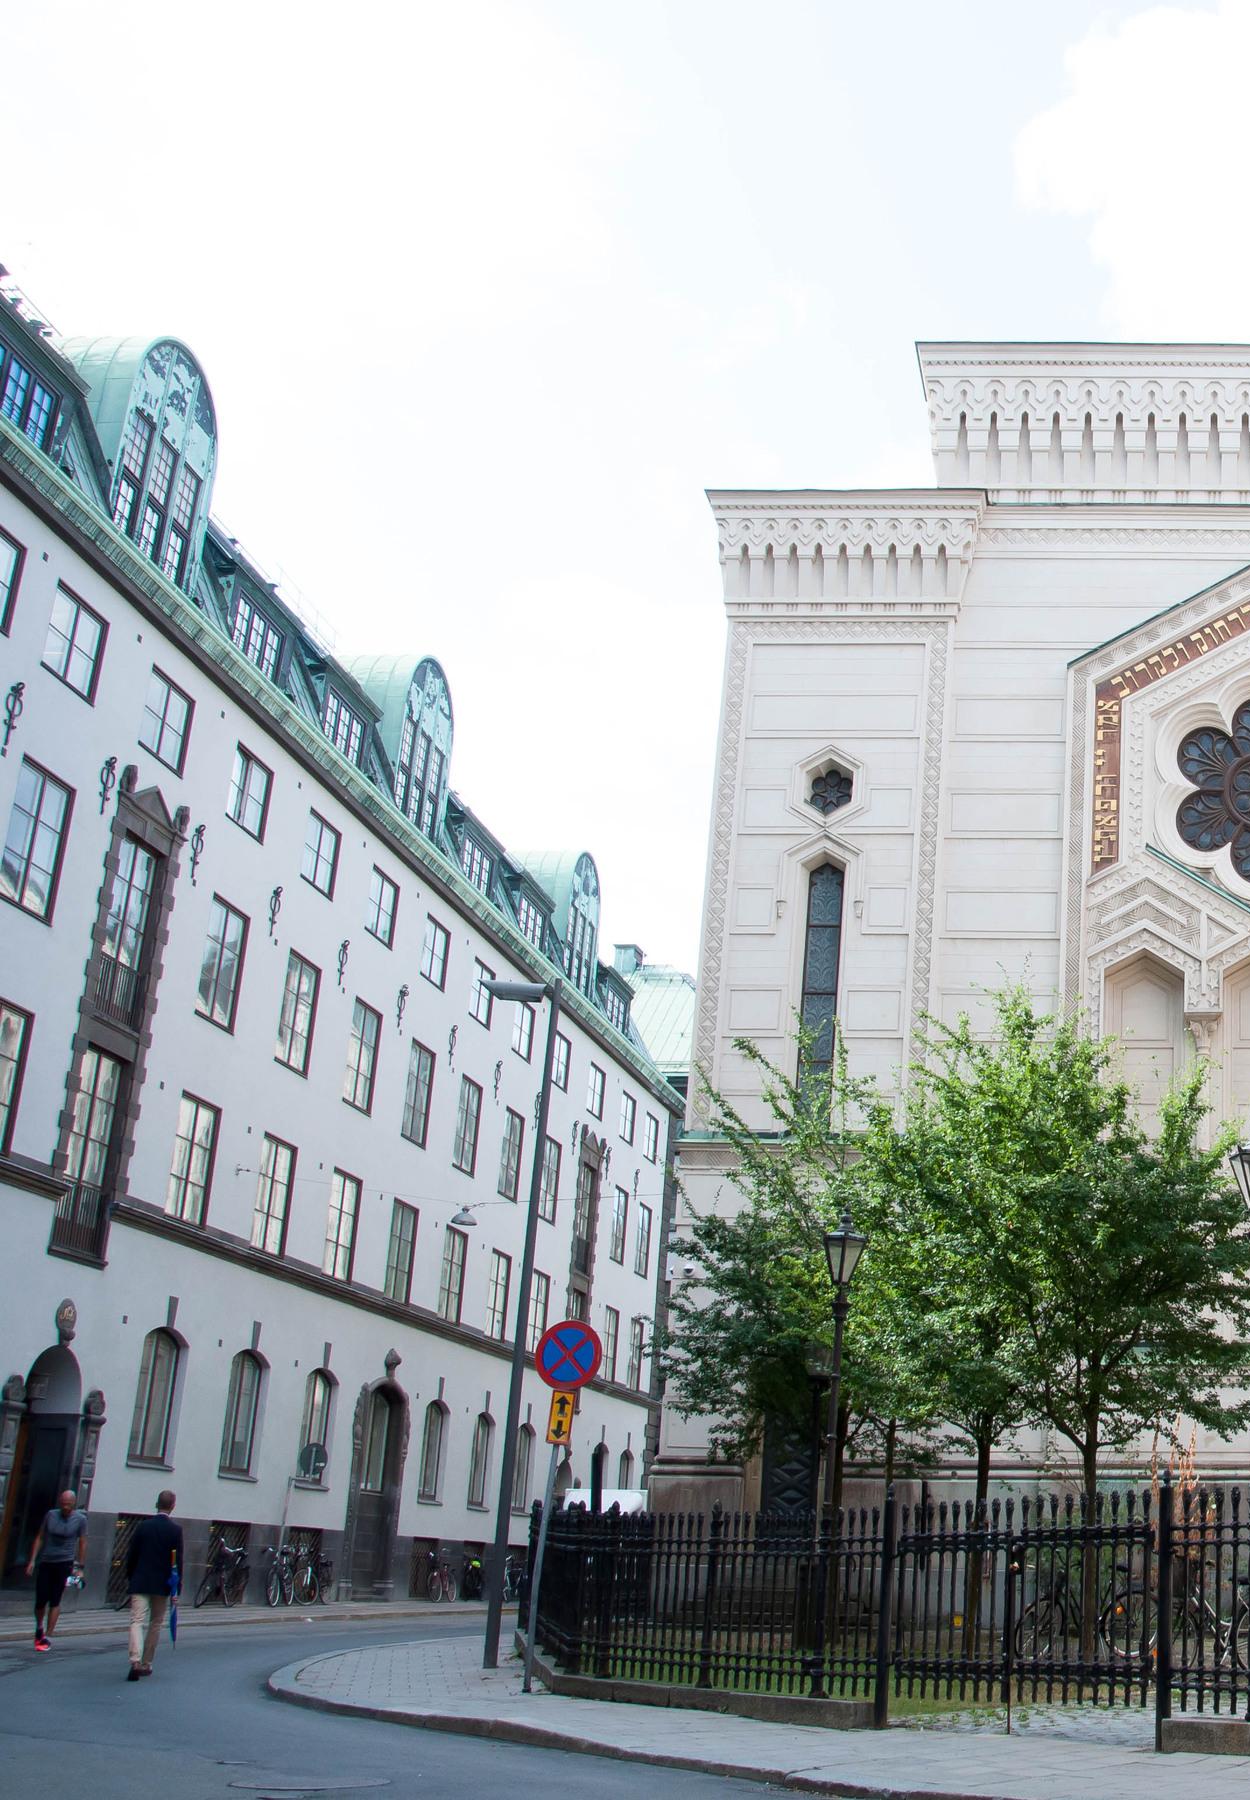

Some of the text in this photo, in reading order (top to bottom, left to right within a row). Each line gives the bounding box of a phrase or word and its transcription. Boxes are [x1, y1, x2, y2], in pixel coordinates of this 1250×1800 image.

[1110, 642, 1190, 698] ולקרוב
[1097, 699, 1119, 741] אמר
[1093, 774, 1118, 862] ורפאתיו
